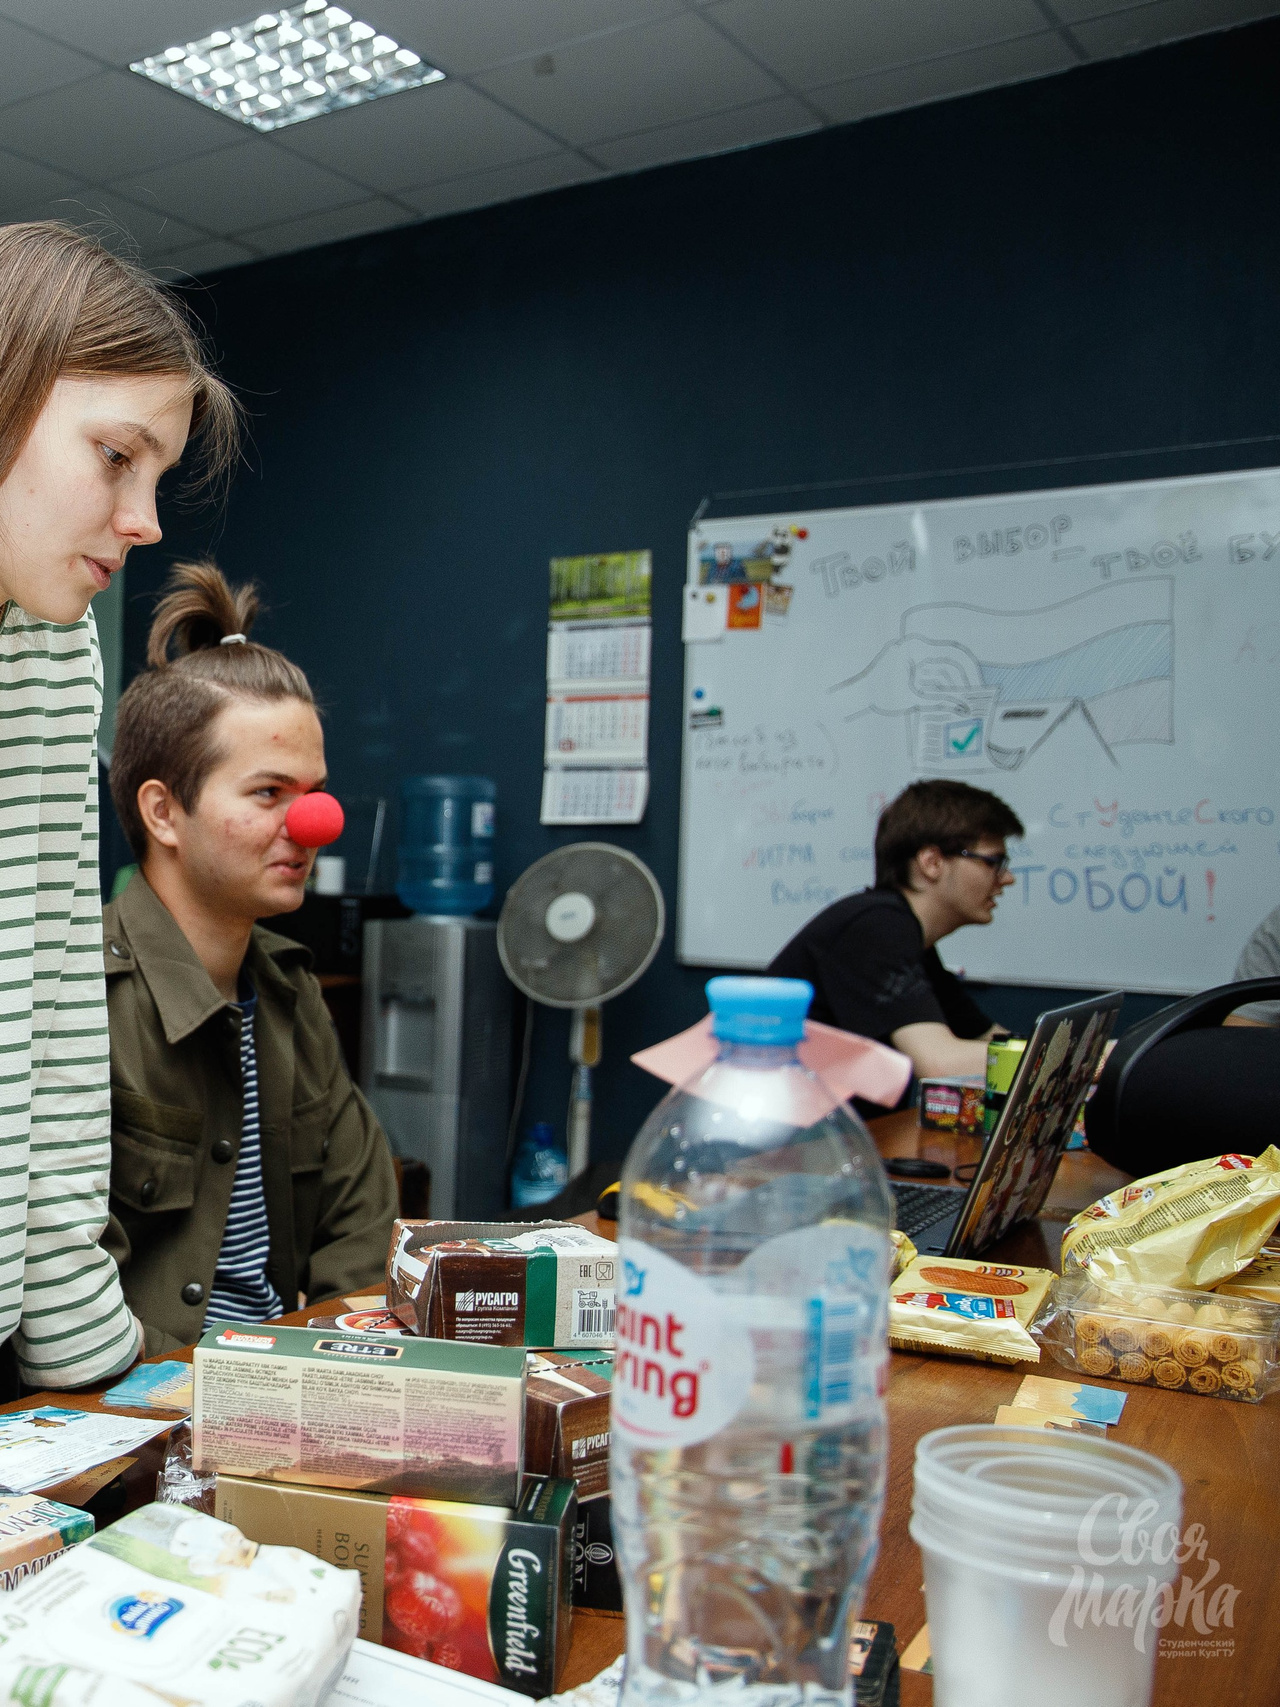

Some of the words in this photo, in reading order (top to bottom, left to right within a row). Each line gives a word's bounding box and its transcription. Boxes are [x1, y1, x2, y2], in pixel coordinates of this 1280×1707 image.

[475, 1292, 519, 1306] РУСАГРО
[330, 1341, 386, 1356] ETRE
[587, 1432, 612, 1451] РУСАГ
[504, 1548, 542, 1676] Greenfield
